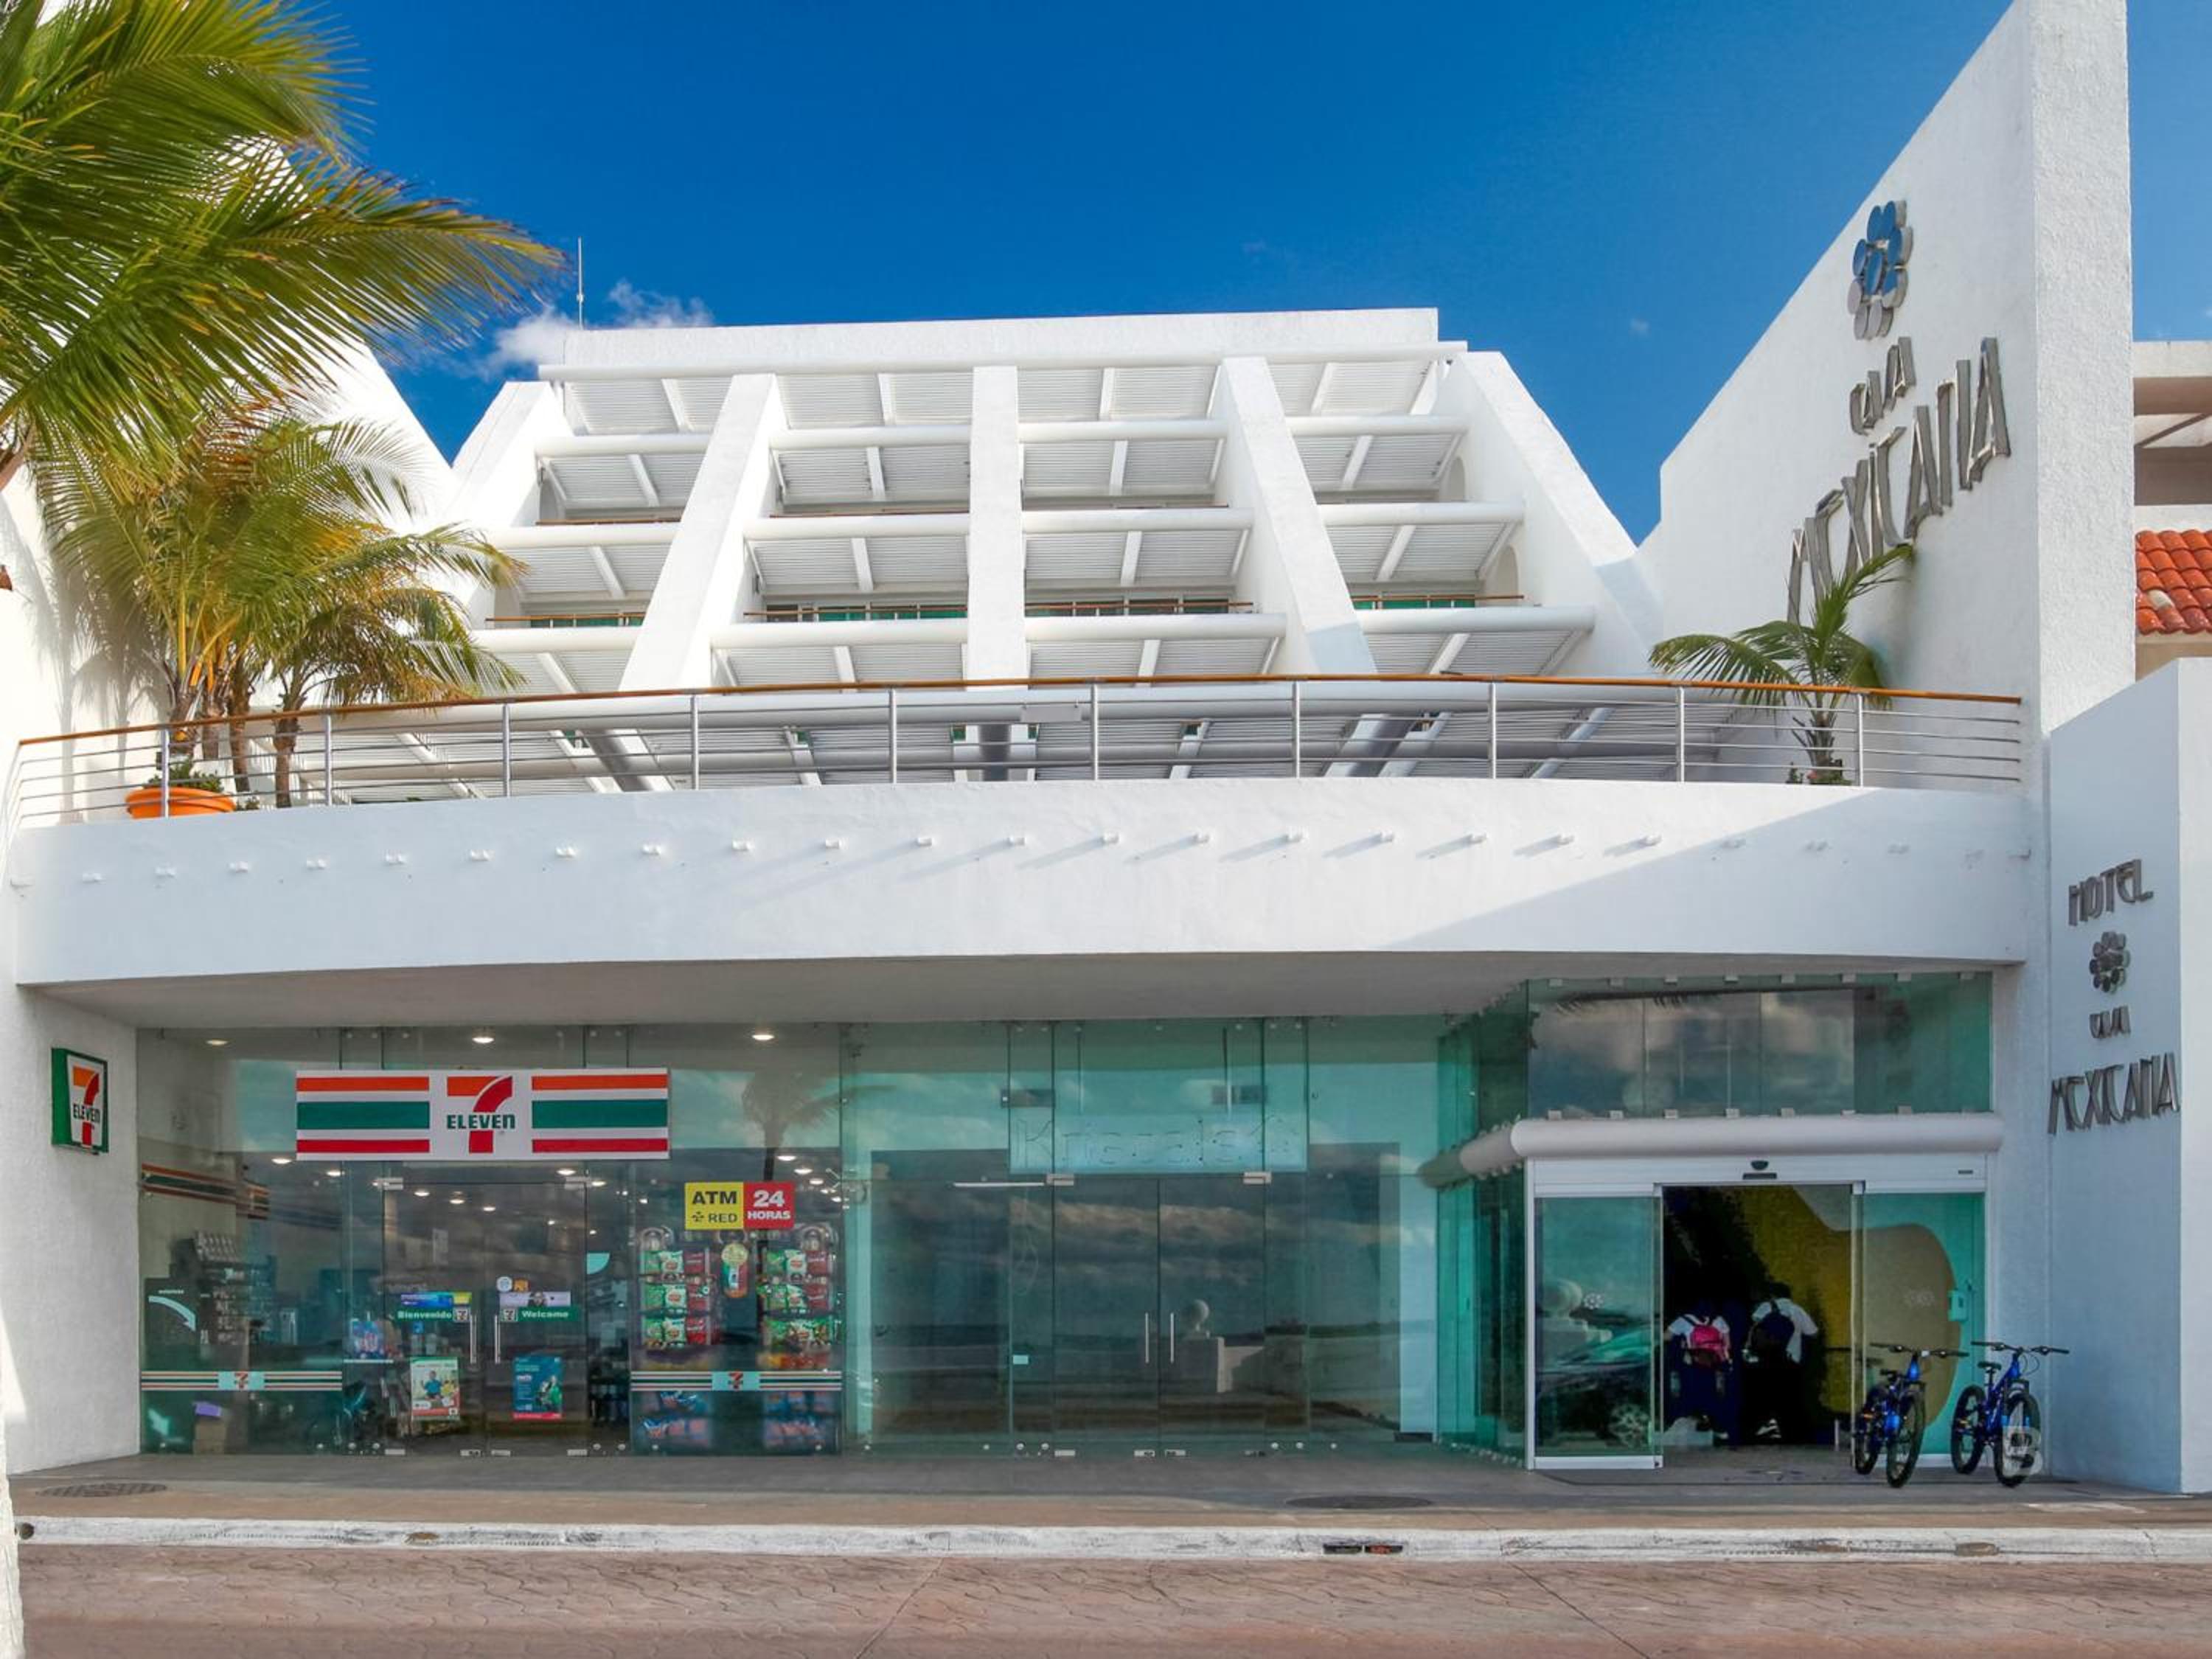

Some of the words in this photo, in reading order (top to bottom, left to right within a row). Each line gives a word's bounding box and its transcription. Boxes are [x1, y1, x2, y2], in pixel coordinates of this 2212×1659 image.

[2068, 859, 2154, 926] HOTEL
[447, 1076, 512, 1153] 7
[692, 1191, 737, 1204] ATM
[753, 1189, 785, 1207] 24
[709, 1213, 737, 1222] RED
[747, 1211, 791, 1220] HORAS
[397, 1310, 452, 1319] Bienvenido
[521, 1310, 568, 1318] Welcome
